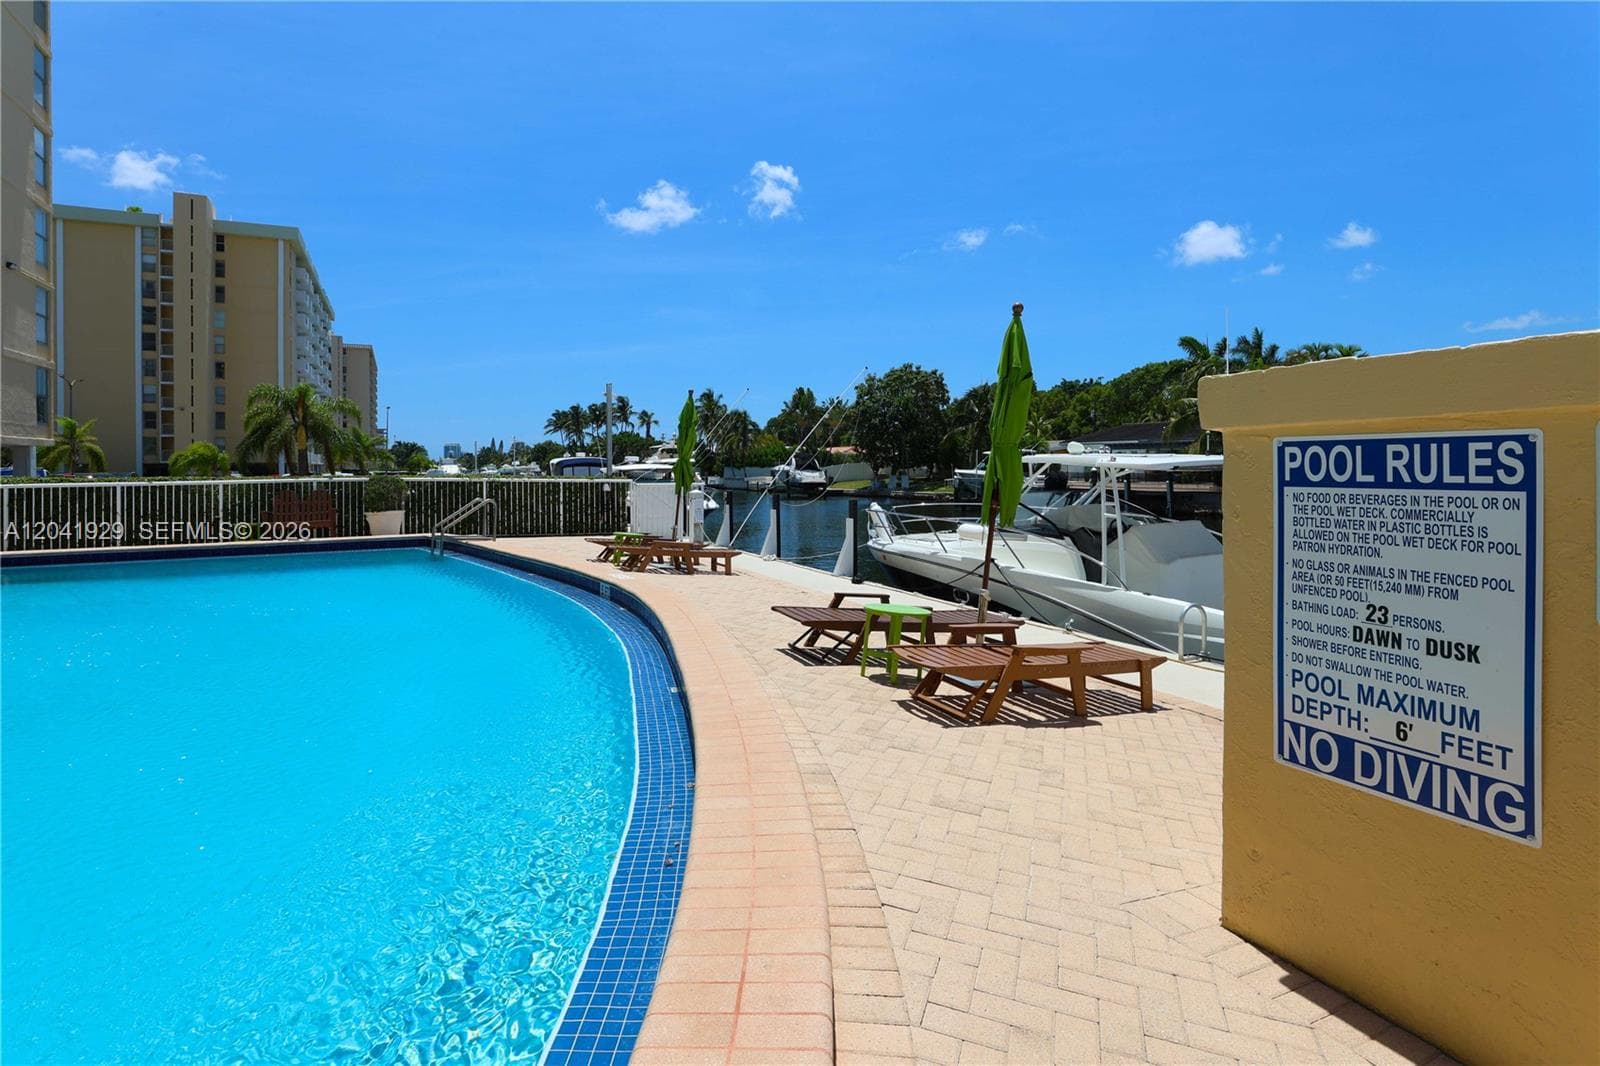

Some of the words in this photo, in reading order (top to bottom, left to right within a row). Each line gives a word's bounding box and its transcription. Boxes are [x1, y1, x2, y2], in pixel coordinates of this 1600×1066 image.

[1284, 444, 1375, 483] POOL
[1386, 440, 1525, 485] RULES
[1292, 492, 1305, 503] NO
[1306, 493, 1331, 504] FOOD
[1333, 493, 1347, 504] OR
[1348, 493, 1408, 507] BEVERAGES
[1410, 495, 1420, 507] IN
[1423, 495, 1445, 508] THE
[1447, 496, 1479, 510] POOL
[1481, 497, 1499, 510] OR
[1502, 497, 1521, 511] ON
[1292, 504, 1309, 515] THE
[1311, 505, 1335, 517] POOL
[1337, 506, 1357, 517] WET
[1390, 508, 1475, 523] COMMERCIALLY
[1292, 516, 1332, 529] BOTTLED
[1334, 518, 1365, 531] WATER
[1367, 520, 1377, 531] IN
[1380, 520, 1421, 535] PLASTIC
[1424, 523, 1474, 538] BOTTLES
[1477, 526, 1489, 539] IS
[1292, 528, 1335, 541] ALLOWED
[1336, 531, 1350, 543] ON
[1352, 532, 1370, 545] THE
[1372, 533, 1400, 547] POOL
[1402, 535, 1425, 548] WET
[1427, 537, 1458, 551] DECK
[1461, 539, 1485, 553] FOR
[1488, 541, 1522, 556] POOL
[1292, 540, 1326, 553] PATRON
[1328, 543, 1383, 559] HYDRATION.
[1292, 558, 1304, 569] NO
[1306, 559, 1335, 573] GLASS
[1337, 562, 1350, 574] OR
[1352, 564, 1395, 580] ANIMALS
[1397, 568, 1407, 580] IN
[1410, 569, 1431, 583] THE
[1433, 572, 1479, 588] FENCED
[1481, 576, 1516, 593] POOL
[1292, 571, 1315, 584] AREA
[1316, 573, 1332, 586] (OR
[1334, 576, 1345, 587] 50
[1404, 583, 1425, 598] MM)
[1427, 585, 1459, 601] FROM
[1292, 583, 1338, 599] UNFENCED
[1339, 589, 1371, 603] POOL).
[1291, 599, 1329, 615] BATHING
[1331, 606, 1359, 620] LOAD:
[1365, 603, 1389, 625] 23
[1392, 614, 1445, 633] PERSONS.
[1291, 619, 1315, 632] POOL
[1316, 623, 1350, 639] HOURS:
[1352, 625, 1402, 650] DAWN
[1406, 637, 1420, 651] TO
[1425, 637, 1481, 665] DUSK
[1291, 635, 1328, 652] SHOWER
[1330, 642, 1367, 660] BEFORE
[1369, 649, 1422, 670] ENTERING.
[1291, 652, 1304, 664] DO
[1305, 655, 1323, 668] NOT
[1325, 658, 1372, 678] SWALLOW
[1374, 668, 1393, 683] THE
[1395, 673, 1424, 690] POOL
[1426, 679, 1469, 699] WATER.
[1291, 668, 1350, 701] POOL
[1357, 683, 1480, 733] MAXIMUM
[1291, 693, 1369, 733] DEPTH:
[1440, 731, 1514, 771] FEET
[1283, 721, 1339, 774] NO
[1354, 742, 1526, 833] DIVING
